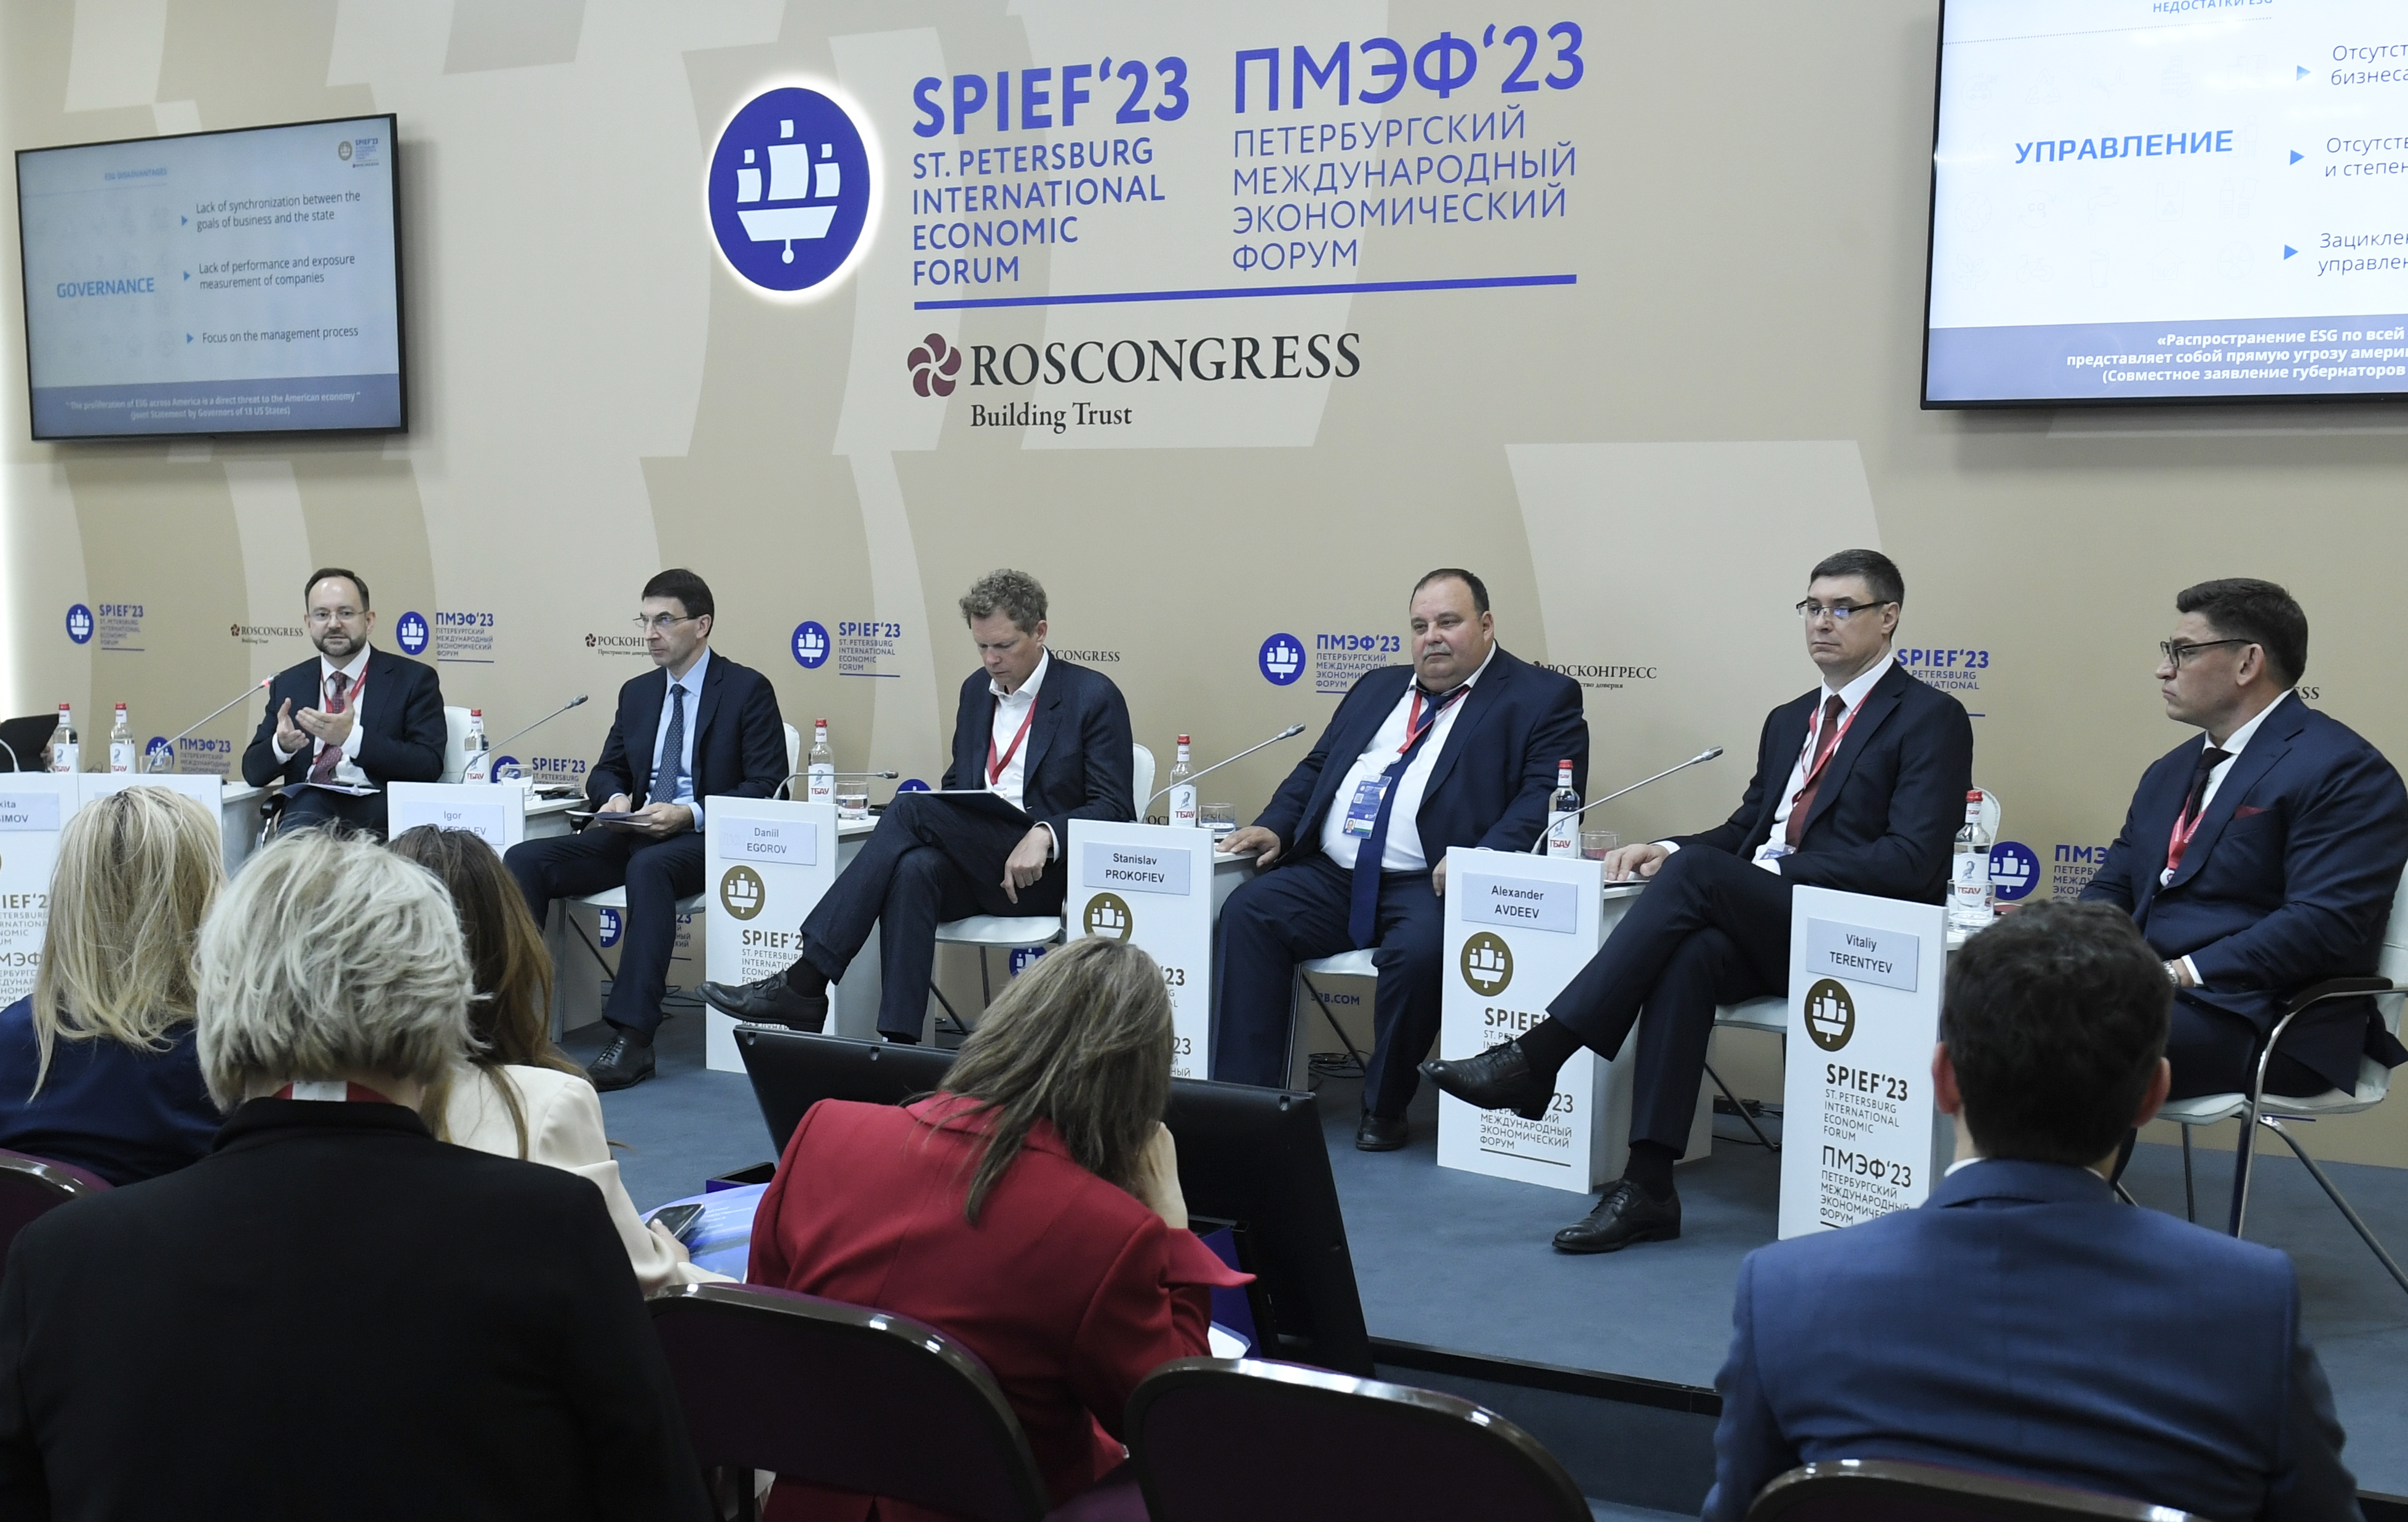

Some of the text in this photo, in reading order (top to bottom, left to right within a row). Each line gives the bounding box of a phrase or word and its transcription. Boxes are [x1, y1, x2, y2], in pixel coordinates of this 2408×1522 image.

[913, 56, 1189, 138] SPIEF'23
[1234, 103, 1525, 158] ПЕТЕРБУРГСКИЙ
[2015, 130, 2234, 164] УПРАВЛЕНИЕ
[913, 137, 1154, 179] ST. PETERSBURG
[1233, 141, 1576, 196] МЕЖДУНАРОДНЫЙ
[2326, 165, 2336, 177] и
[196, 190, 360, 214] Lack of synchronization between the
[913, 174, 1166, 215] INTERNATIONAL
[1233, 182, 1566, 234] ЭКОНОМИЧЕСКИЙ
[197, 210, 335, 232] goals of business and the state
[913, 216, 1079, 251] ECONOMIC
[199, 255, 356, 274] Lack of performance and exposure
[1233, 239, 1357, 272] ФОРУМ
[200, 272, 325, 290] measurement of companies
[913, 256, 1020, 286] FORUM
[57, 277, 155, 298] GOVERNANCE
[202, 327, 359, 343] Focus on the management process
[2310, 329, 2338, 343] ESG
[2342, 330, 2362, 341] по
[2366, 327, 2405, 341] всей
[970, 333, 1361, 387] ROSCONGRESS
[2067, 347, 2408, 369] представляет собой прямую угрозу амери
[2102, 365, 2406, 384] (Совместное заявление губернаторов
[971, 401, 1132, 434] Building Trust
[241, 626, 304, 637] ROSCONGRESS
[839, 647, 896, 656] INTERNATIONAL
[1316, 653, 1386, 662] ПЕТЕРБУРГСКИЙ
[1912, 670, 1977, 680] PETERSBURG
[541, 773, 579, 782] PETERSBURG
[444, 811, 462, 821] Igor
[755, 827, 779, 838] Daniil
[747, 842, 787, 854] EGOROV
[1549, 839, 1571, 848] ТБАУ
[1113, 853, 1157, 865] Stanislav
[1105, 869, 1165, 883] PROKOFIEV
[1491, 885, 1544, 901] Alexander
[1957, 886, 1982, 895] ТБАУ
[1494, 904, 1540, 919] AVDEEV
[742, 929, 803, 950] SPIEF'2
[1846, 933, 1877, 952] Vitaliy
[1829, 951, 1893, 973] TERENTYEV
[1484, 1030, 1496, 1039] ST.
[1826, 1063, 1907, 1101] SPIEF'23
[1826, 1088, 1896, 1114] ST. PETERSBURG
[1824, 1101, 1899, 1127] INTERNATIONAL
[1824, 1113, 1874, 1133] ECONOMIC
[1480, 1113, 1572, 1138] МЕЖДУНАРОДНЫЙ
[1824, 1125, 1856, 1141] FORUM
[1480, 1124, 1569, 1148] ЭКОНОМИЧЕСКИЙ
[1480, 1136, 1515, 1149] ФОРУМ
[1822, 1145, 1911, 1187] ПМЭФ'23
[1821, 1170, 1897, 1199] ПЕТЕРБУРГСКИЙ
[1820, 1207, 1854, 1225] ФОРУМ
